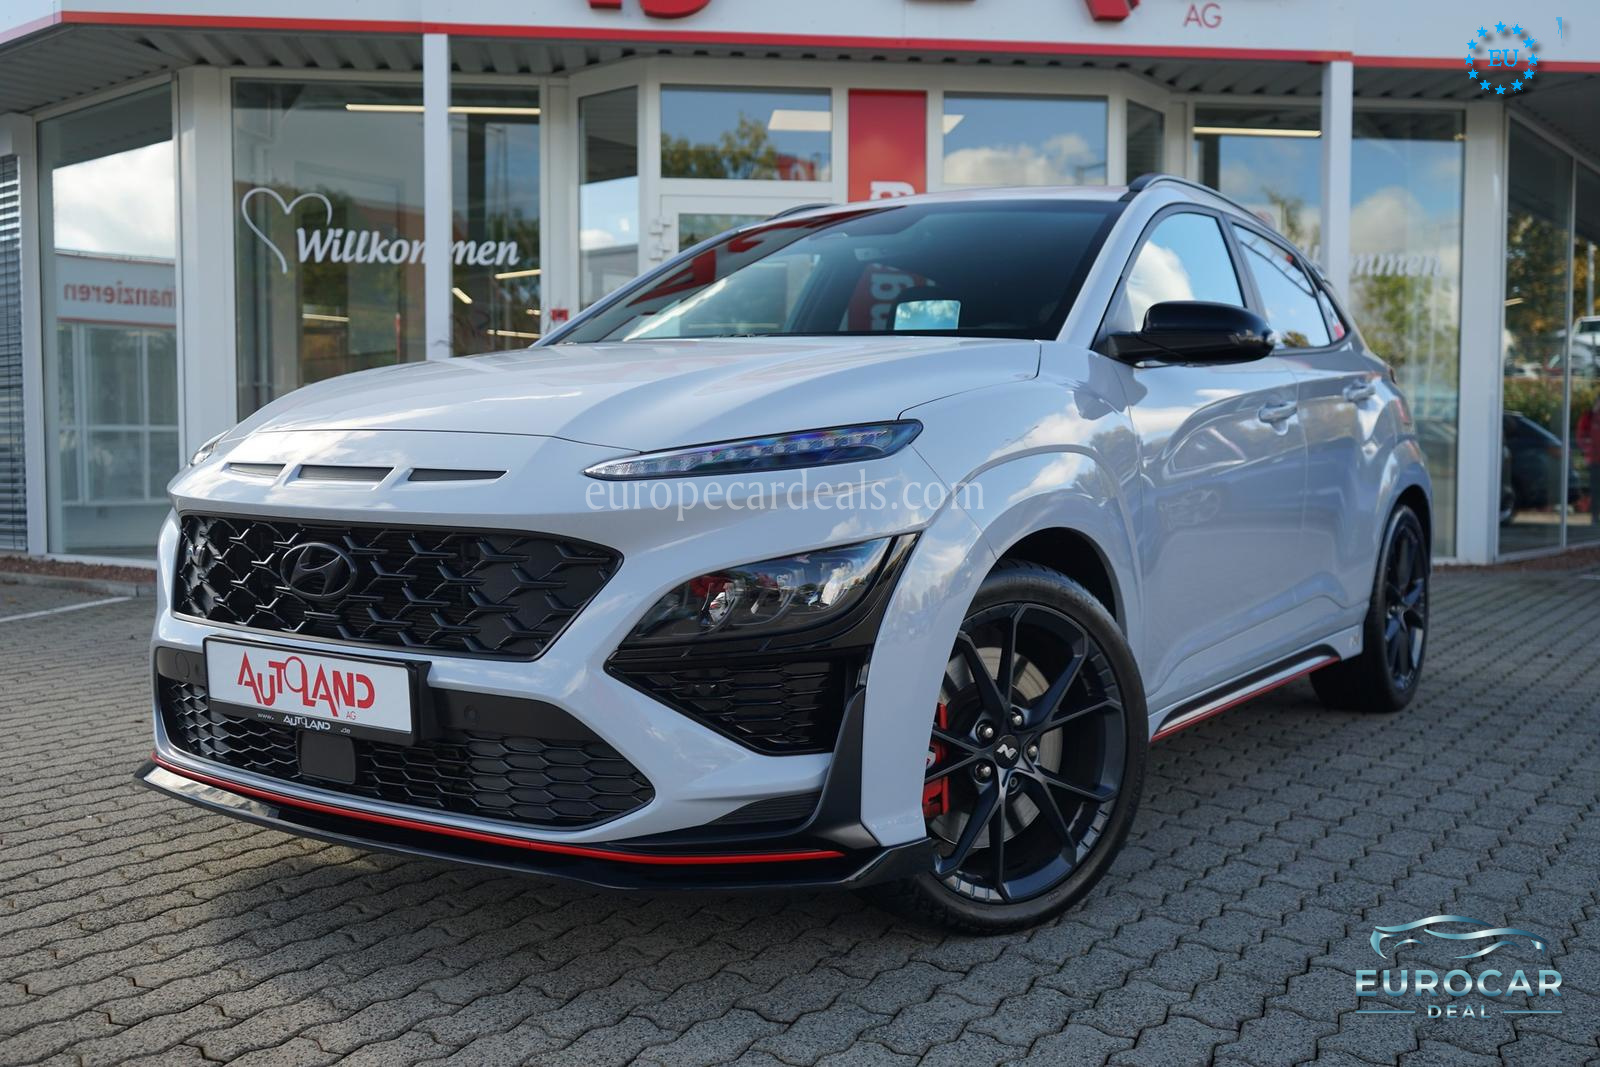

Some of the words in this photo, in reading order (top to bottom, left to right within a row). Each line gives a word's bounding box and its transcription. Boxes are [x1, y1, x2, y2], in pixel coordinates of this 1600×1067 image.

[1184, 3, 1222, 28] AG
[237, 651, 376, 717] AUTOLAND
[346, 710, 357, 720] AG
